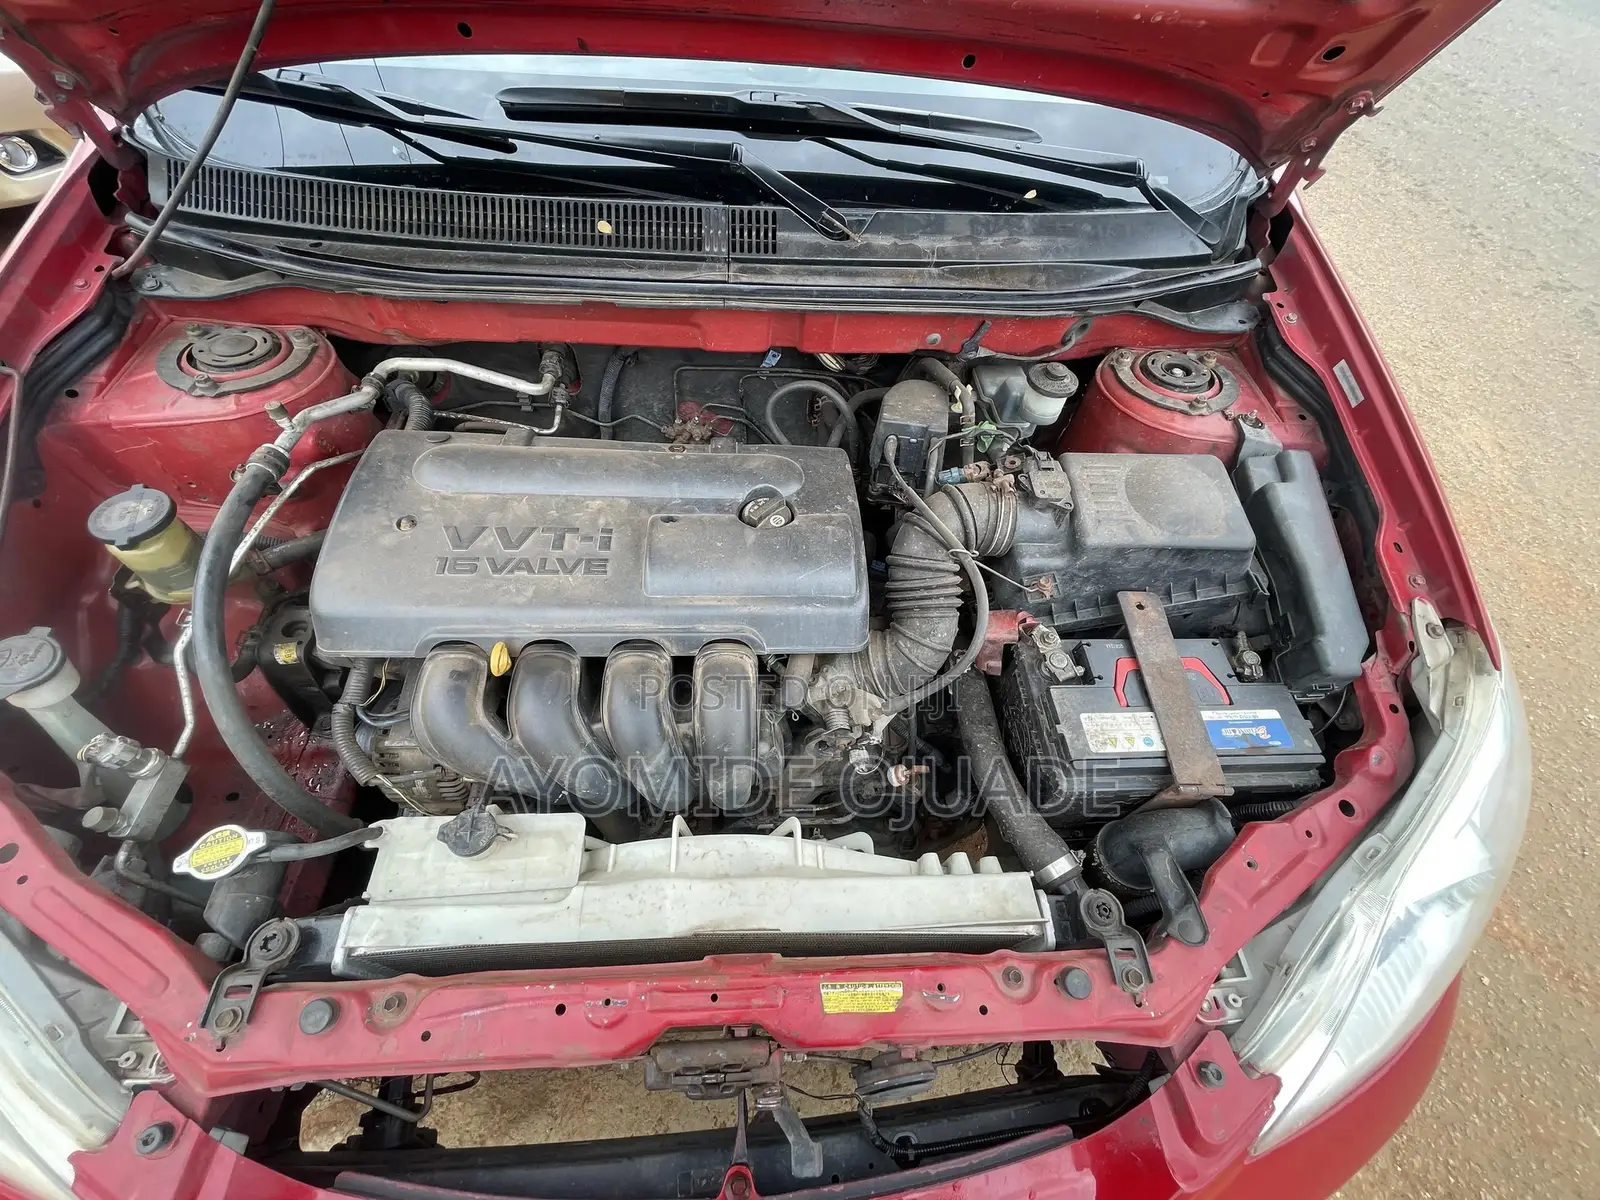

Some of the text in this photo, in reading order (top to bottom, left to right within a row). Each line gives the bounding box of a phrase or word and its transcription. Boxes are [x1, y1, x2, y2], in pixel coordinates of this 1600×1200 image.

[442, 525, 614, 552] VVT-i
[435, 556, 609, 577] 16 VALVE
[199, 832, 238, 849] CAUTION
